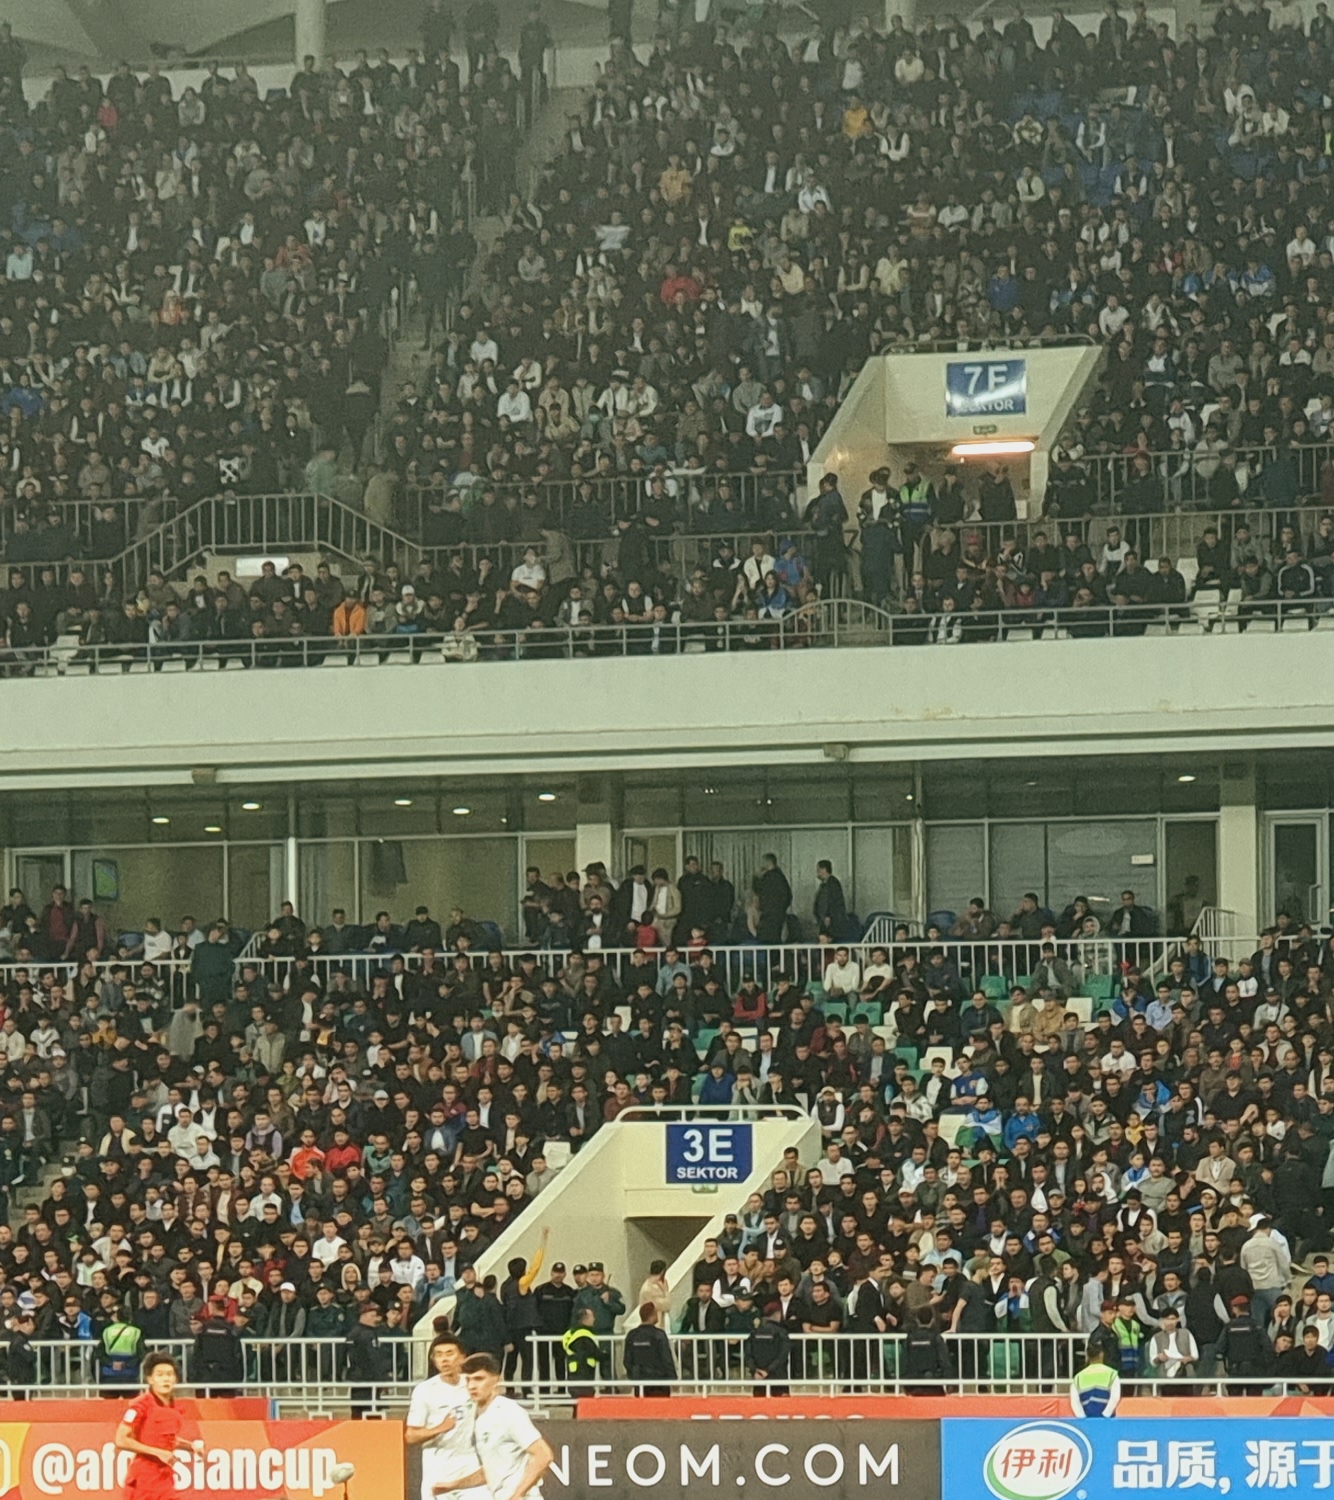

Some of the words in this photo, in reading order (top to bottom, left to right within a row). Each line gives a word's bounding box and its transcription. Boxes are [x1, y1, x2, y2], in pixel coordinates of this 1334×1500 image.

[683, 1128, 734, 1162] 3E
[676, 1167, 738, 1179] SEKTOR
[1000, 1447, 1073, 1479] 伊利
